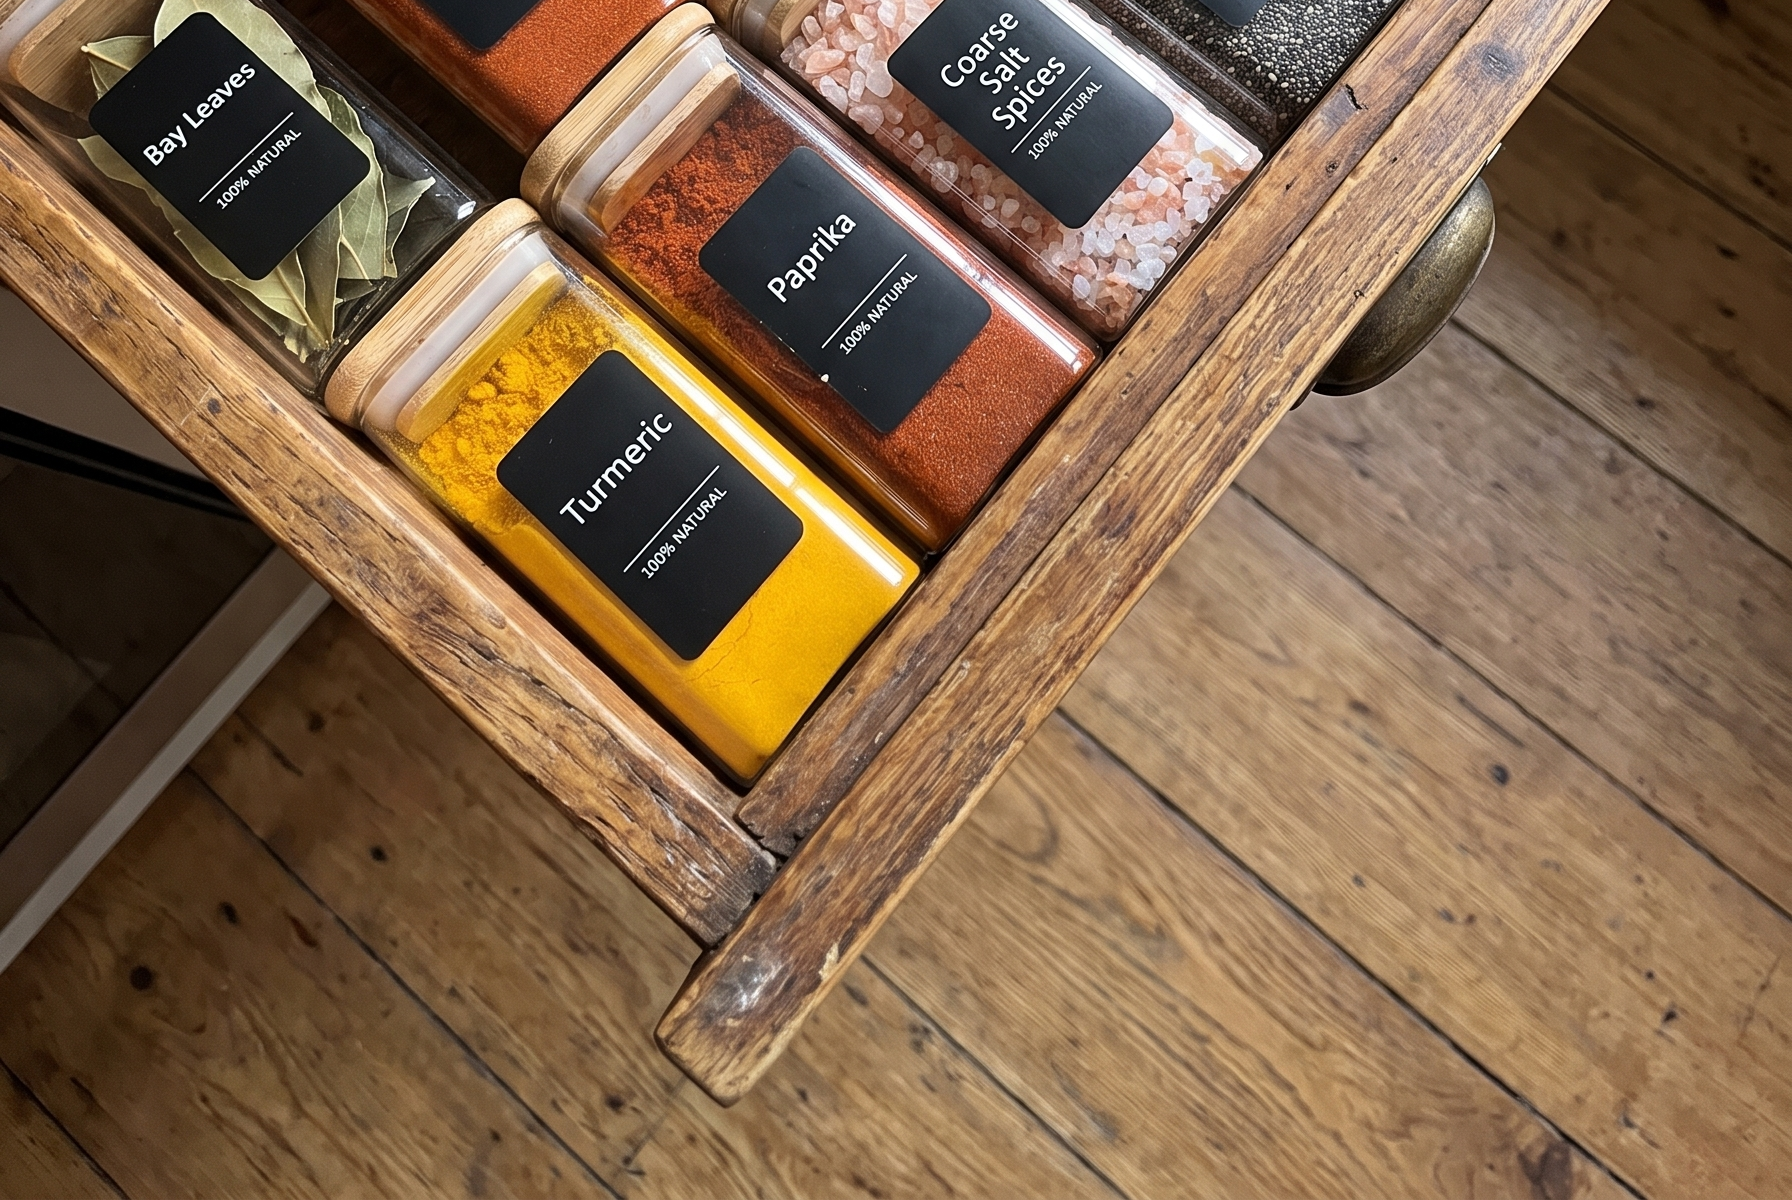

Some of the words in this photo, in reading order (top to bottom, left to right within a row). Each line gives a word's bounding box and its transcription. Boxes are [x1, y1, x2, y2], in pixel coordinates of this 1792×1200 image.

[941, 13, 1019, 88] Coarse
[979, 47, 1030, 94] Salt
[143, 125, 188, 166] Bay
[182, 63, 255, 129] Leaves
[992, 56, 1066, 130] Spices
[1028, 129, 1058, 160] 100%
[1055, 81, 1102, 130] NATURAL
[216, 176, 250, 210] 100%
[247, 129, 301, 178] NATURAL
[767, 214, 857, 303] Paprika
[839, 321, 871, 355] 100%
[867, 271, 918, 324] NATURAL
[559, 413, 673, 525] Turmeric
[641, 542, 676, 579] 100%
[672, 487, 727, 545] NATURAL
